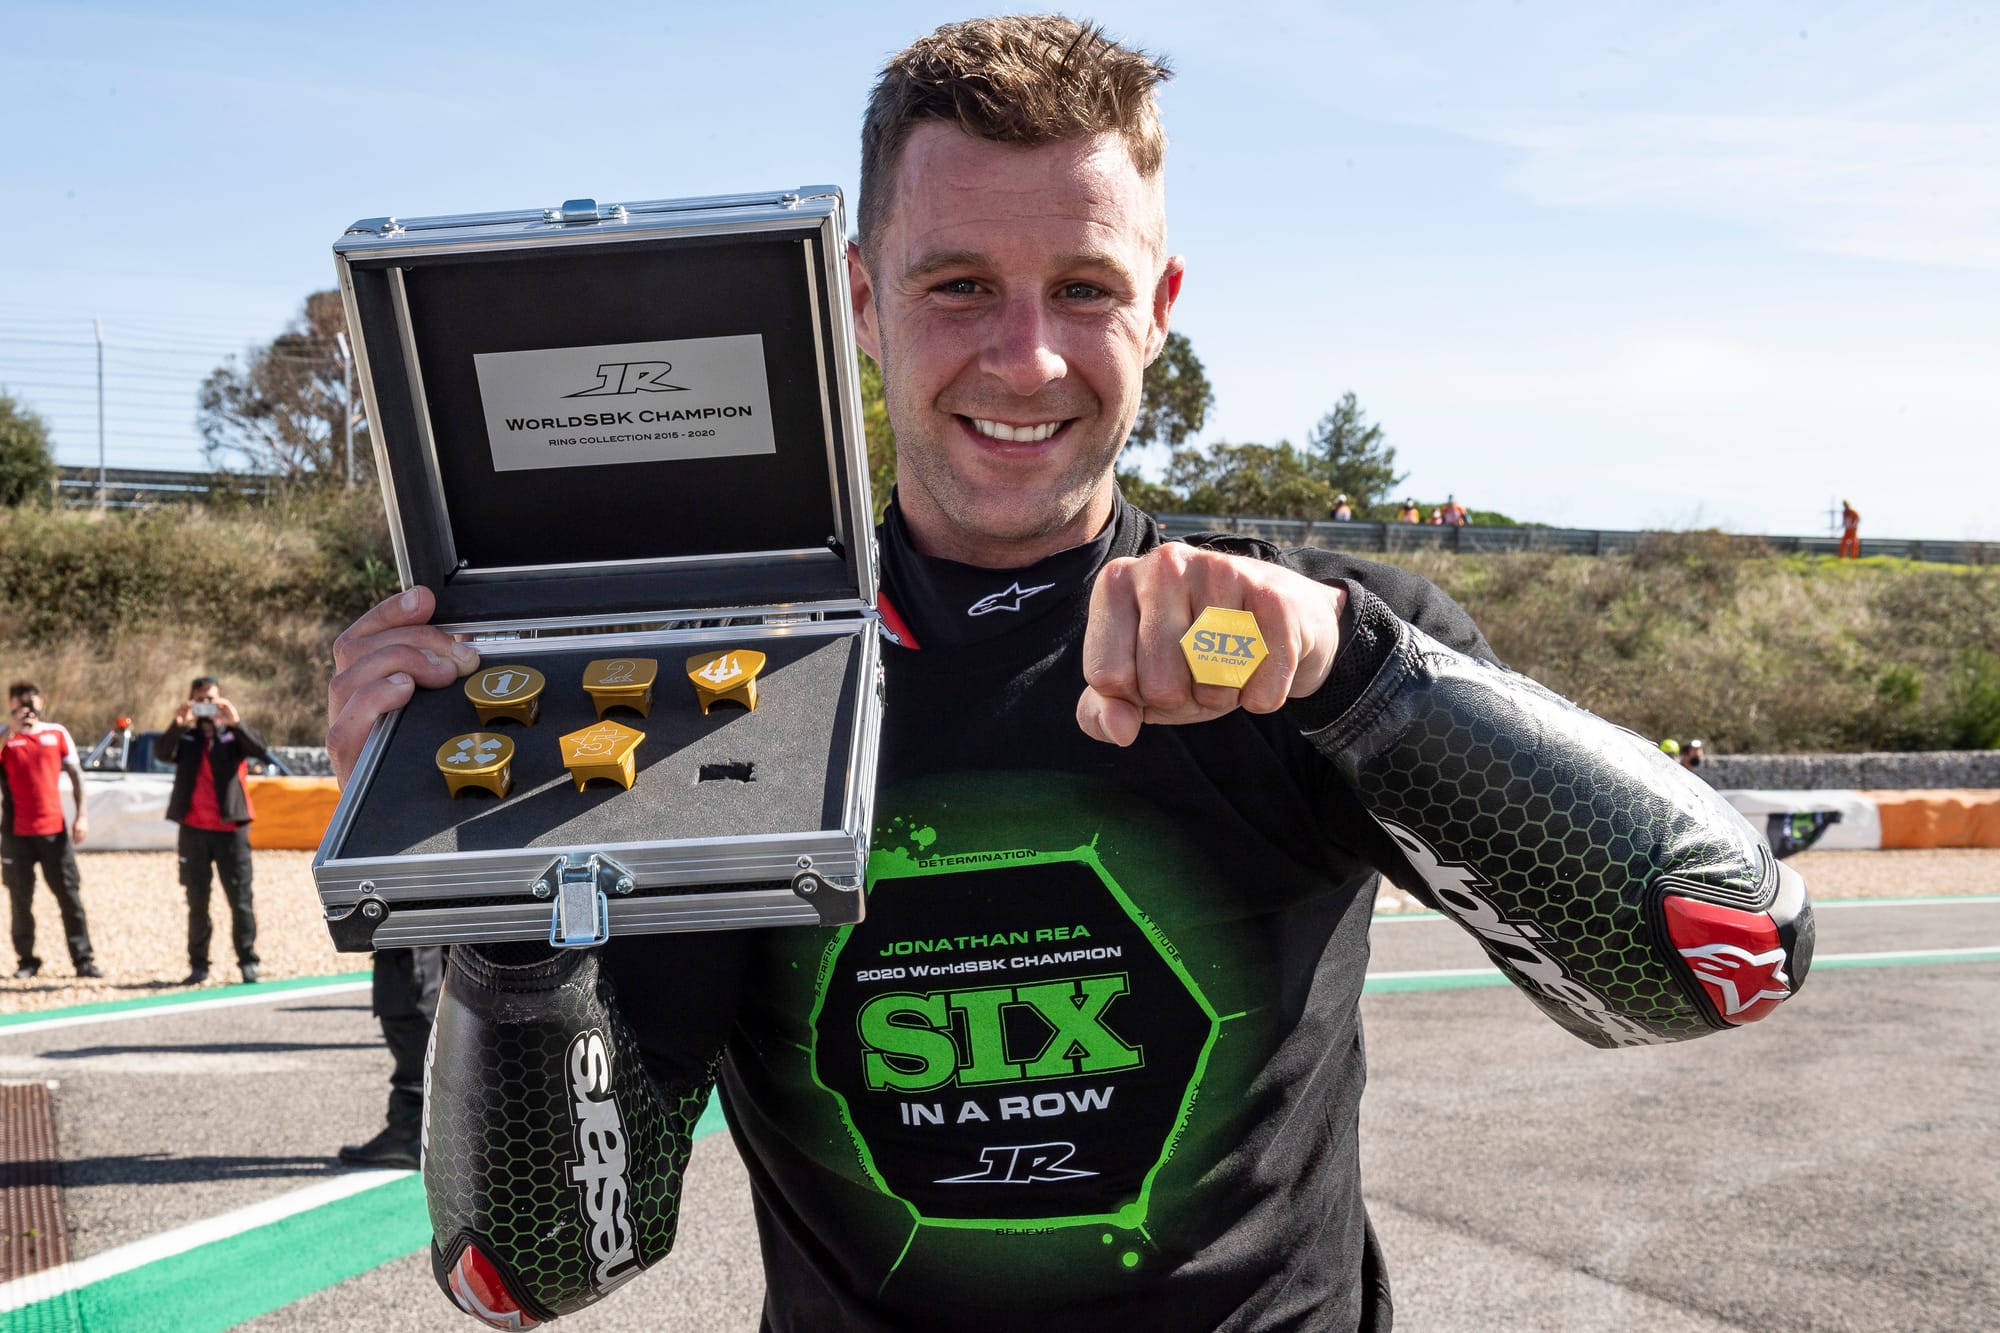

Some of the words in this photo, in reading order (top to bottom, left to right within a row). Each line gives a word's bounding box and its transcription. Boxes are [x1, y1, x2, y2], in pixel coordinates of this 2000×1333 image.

[548, 438, 577, 447] RING
[579, 433, 653, 446] COLLECTION
[654, 431, 679, 440] 2015
[687, 429, 716, 438] 2020
[1193, 630, 1257, 659] SIX
[1220, 657, 1248, 667] ROW
[491, 673, 514, 694] 1
[918, 850, 1037, 869] DETERMINATION
[879, 929, 1029, 957] JONATHAN
[1036, 925, 1092, 943] REA
[1138, 912, 1182, 963] ATTITUDE
[815, 935, 841, 997] SACRIFICE
[856, 967, 907, 982] 2020
[909, 958, 1007, 977] WorldSBK
[1010, 946, 1123, 969] CHAMPION
[856, 971, 1146, 1093] SIX
[900, 1101, 946, 1126] IN
[956, 1100, 991, 1123] A
[999, 1086, 1115, 1121] ROW
[1162, 1083, 1201, 1166] CONSTANCY
[995, 1227, 1056, 1236] BELIEVE
